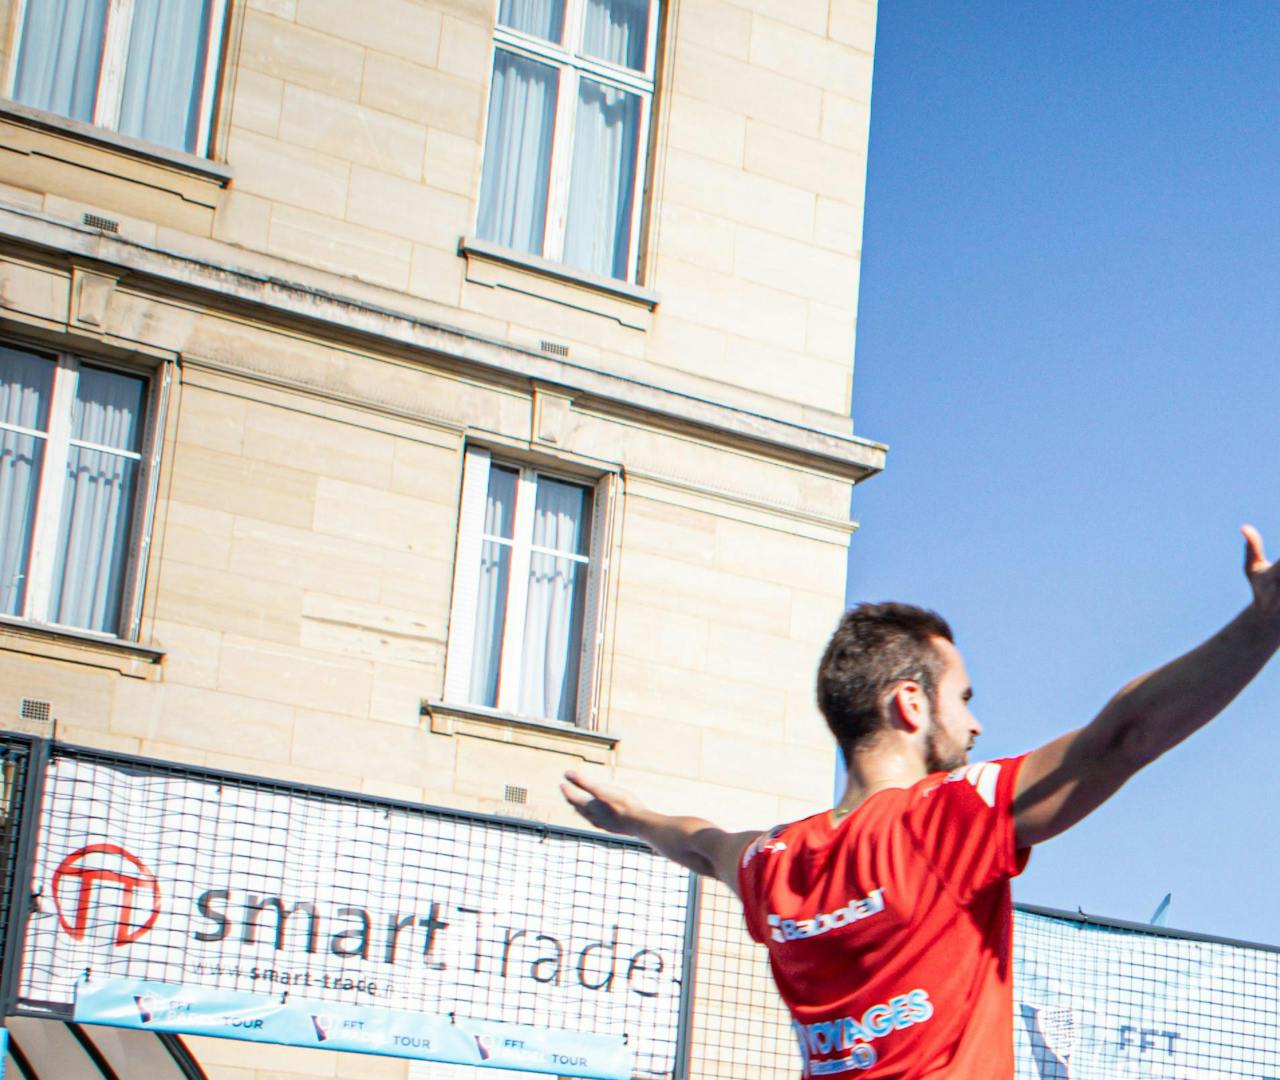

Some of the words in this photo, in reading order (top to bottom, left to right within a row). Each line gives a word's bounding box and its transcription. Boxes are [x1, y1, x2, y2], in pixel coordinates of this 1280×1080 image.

[222, 1015, 264, 1029] TOUR
[393, 1035, 431, 1049] TOUR
[1119, 1025, 1181, 1056] FFT
[551, 1053, 588, 1067] TOUR
